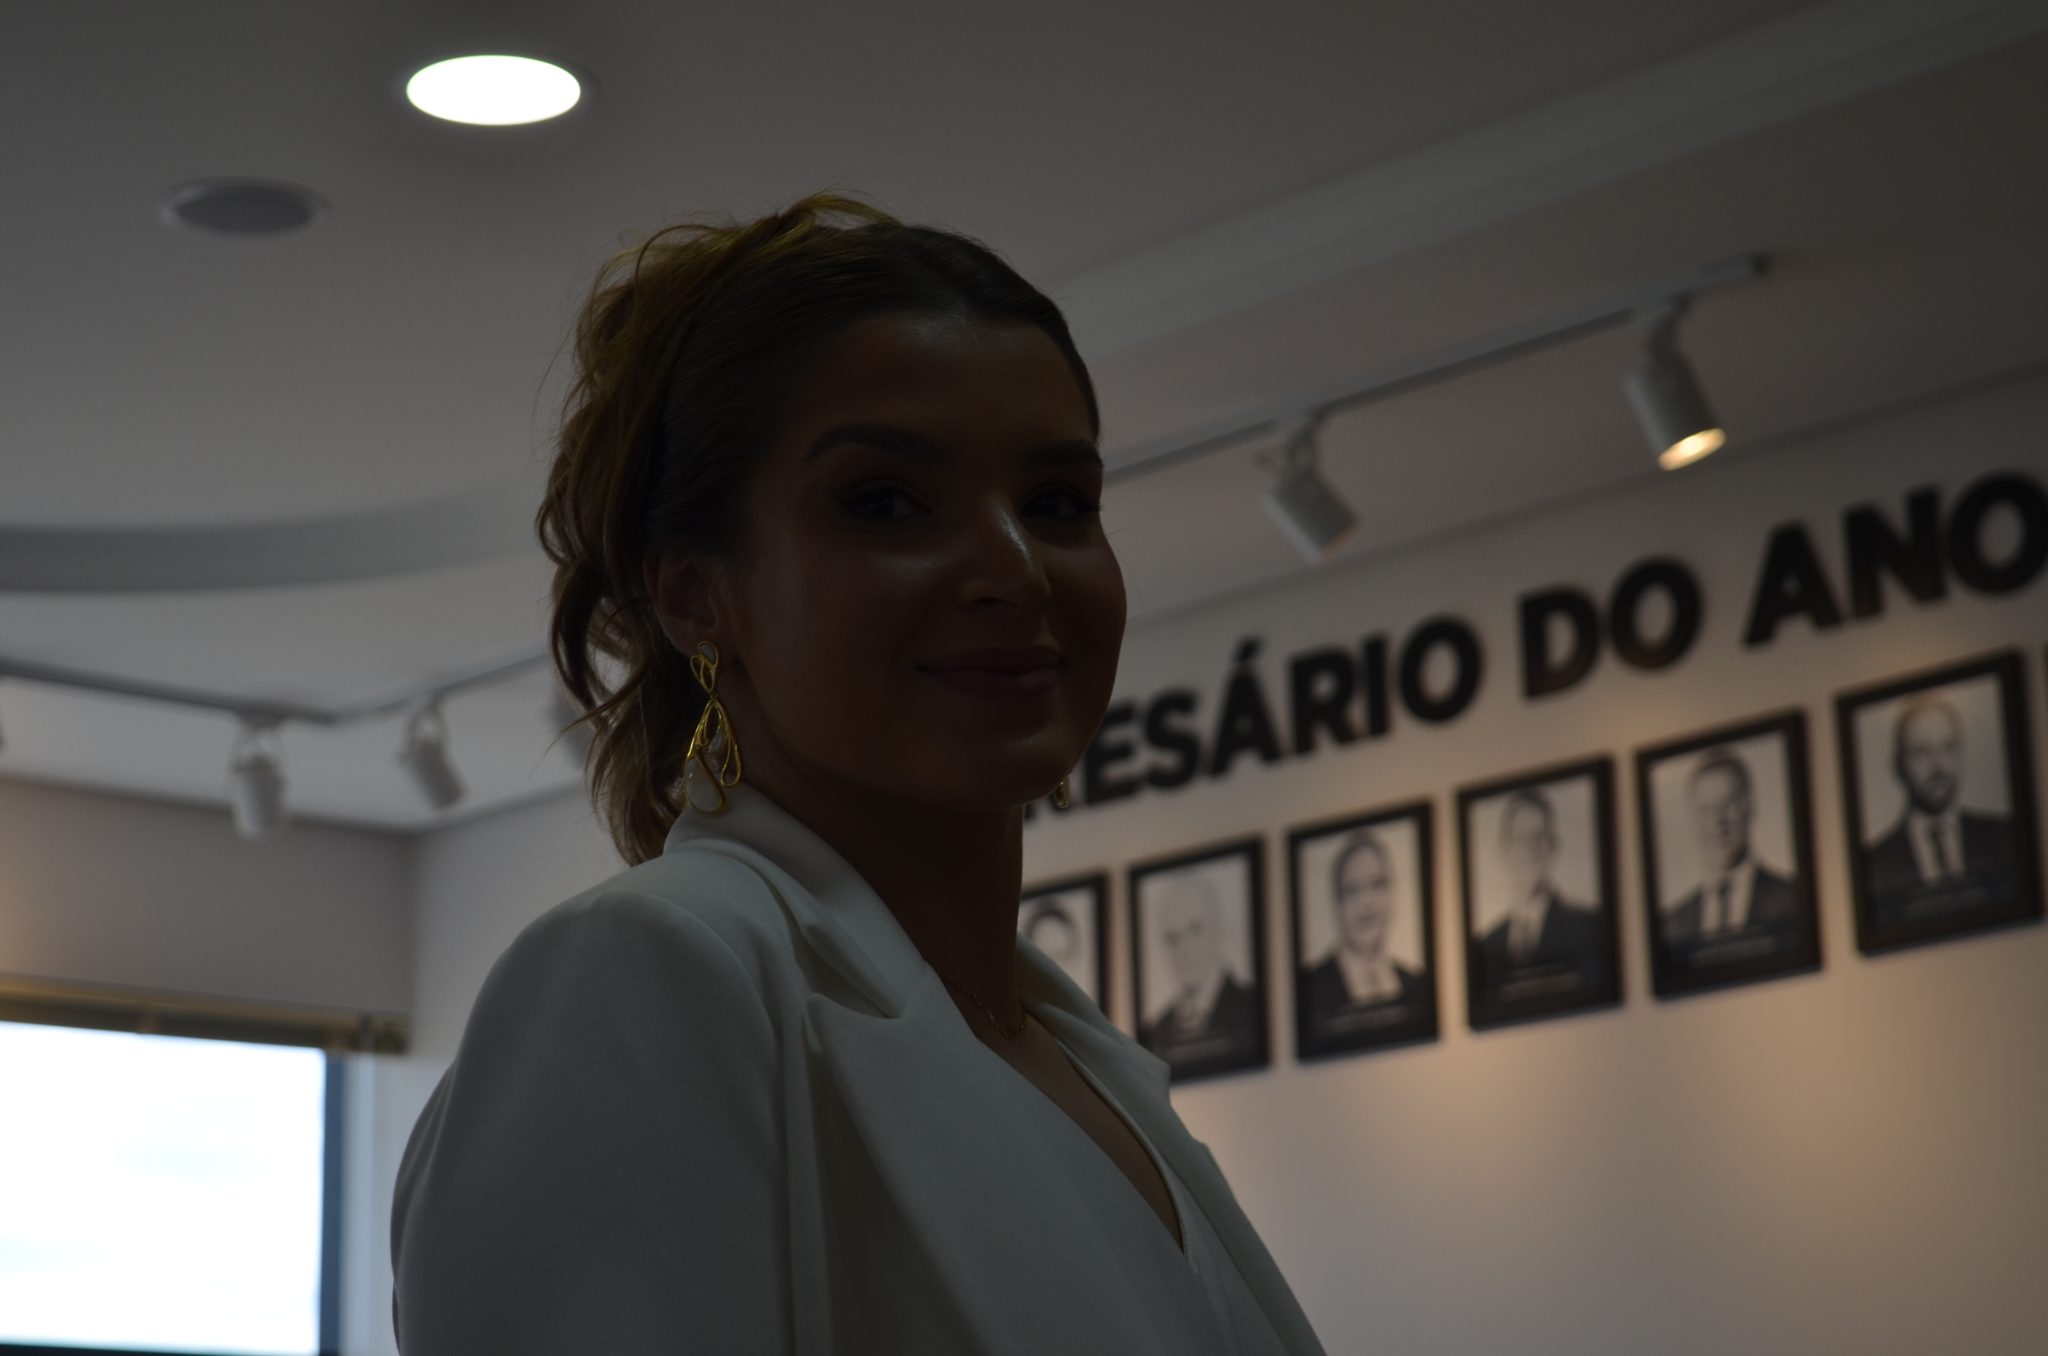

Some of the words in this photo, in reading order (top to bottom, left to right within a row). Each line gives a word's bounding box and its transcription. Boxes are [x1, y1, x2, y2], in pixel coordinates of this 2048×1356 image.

[1023, 617, 1481, 822] ESÁRIO
[1521, 557, 1702, 698] DO
[1746, 473, 2048, 646] ANO
